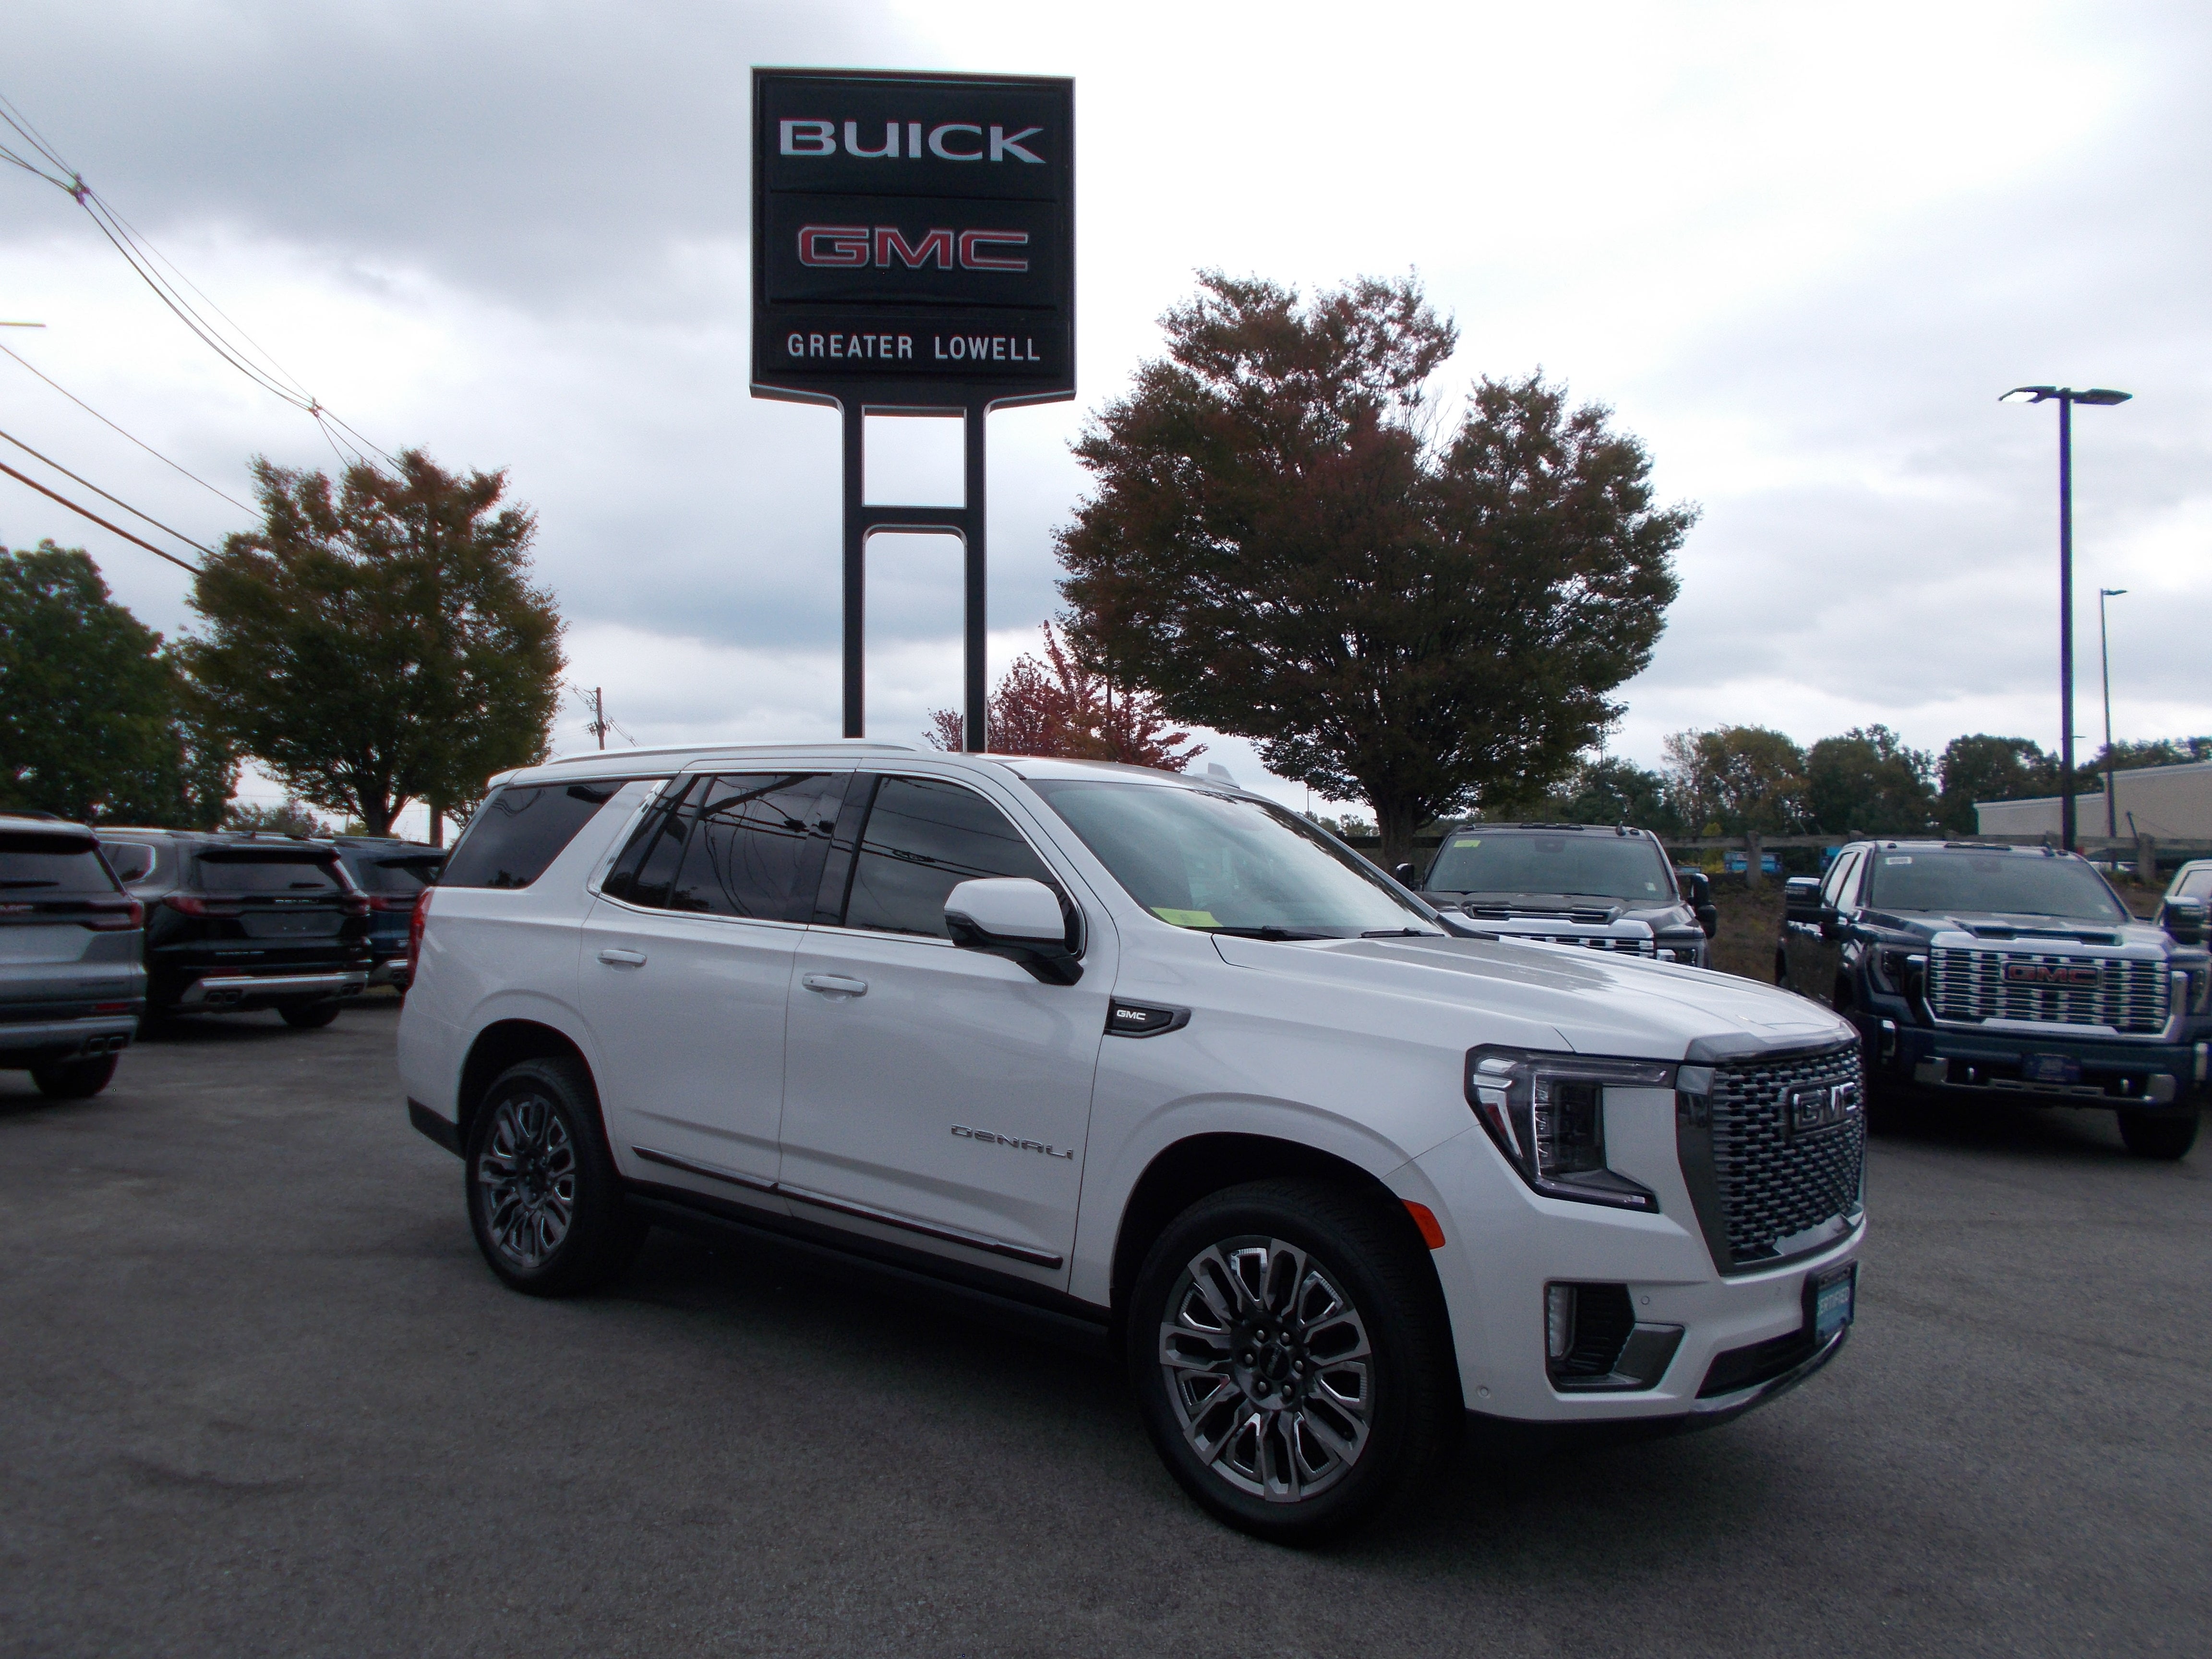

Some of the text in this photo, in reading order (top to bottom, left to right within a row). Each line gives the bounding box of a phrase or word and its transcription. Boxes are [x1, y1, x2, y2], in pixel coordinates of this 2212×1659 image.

[780, 120, 1046, 164] BUICK
[798, 226, 1029, 272] GMC
[787, 333, 1041, 361] GREATER LOWELL
[2008, 965, 2096, 984] GMC
[1117, 1010, 1146, 1021] GMC
[1793, 1082, 1857, 1130] GMC
[951, 1123, 1073, 1160] DENALI
